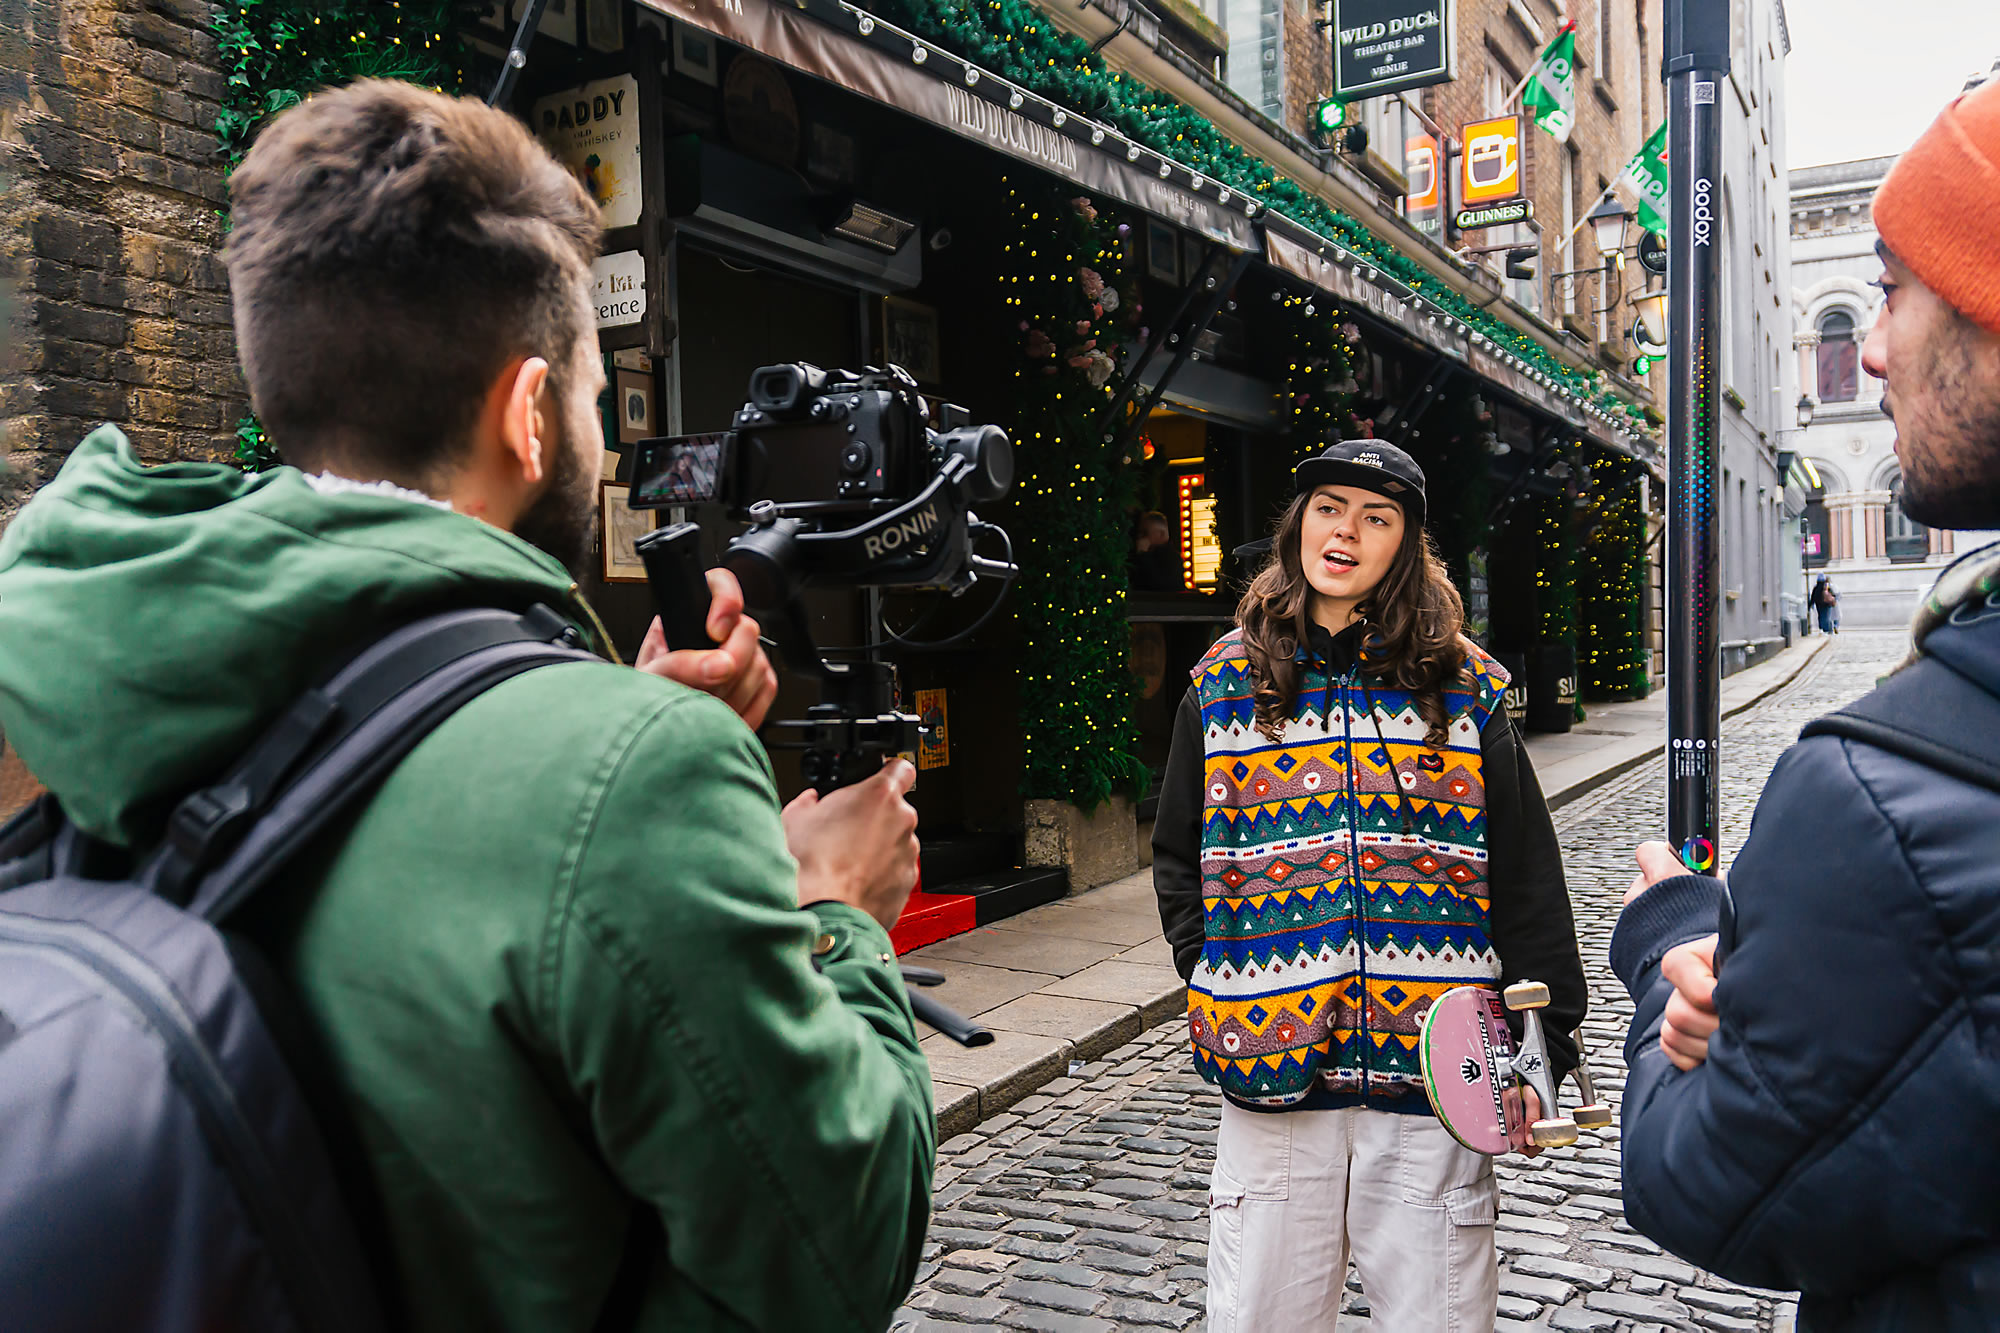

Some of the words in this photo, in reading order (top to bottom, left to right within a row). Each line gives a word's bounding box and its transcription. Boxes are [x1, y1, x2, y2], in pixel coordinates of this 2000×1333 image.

[1340, 23, 1386, 46] WILD
[1388, 9, 1439, 36] DUCK
[1353, 39, 1402, 59] THEATRE
[1403, 34, 1425, 49] BAR
[1384, 53, 1394, 64] &
[1370, 61, 1408, 79] VENUE
[543, 89, 625, 129] PADDY
[942, 81, 986, 133] WILD
[985, 100, 1029, 152] DUCK
[1027, 119, 1077, 173] DUBLIN
[1457, 204, 1526, 229] GUINNESS
[1694, 178, 1715, 248] Godox
[1352, 457, 1384, 468] RACISM
[1359, 452, 1380, 460] ANTI
[863, 503, 938, 559] RONIN
